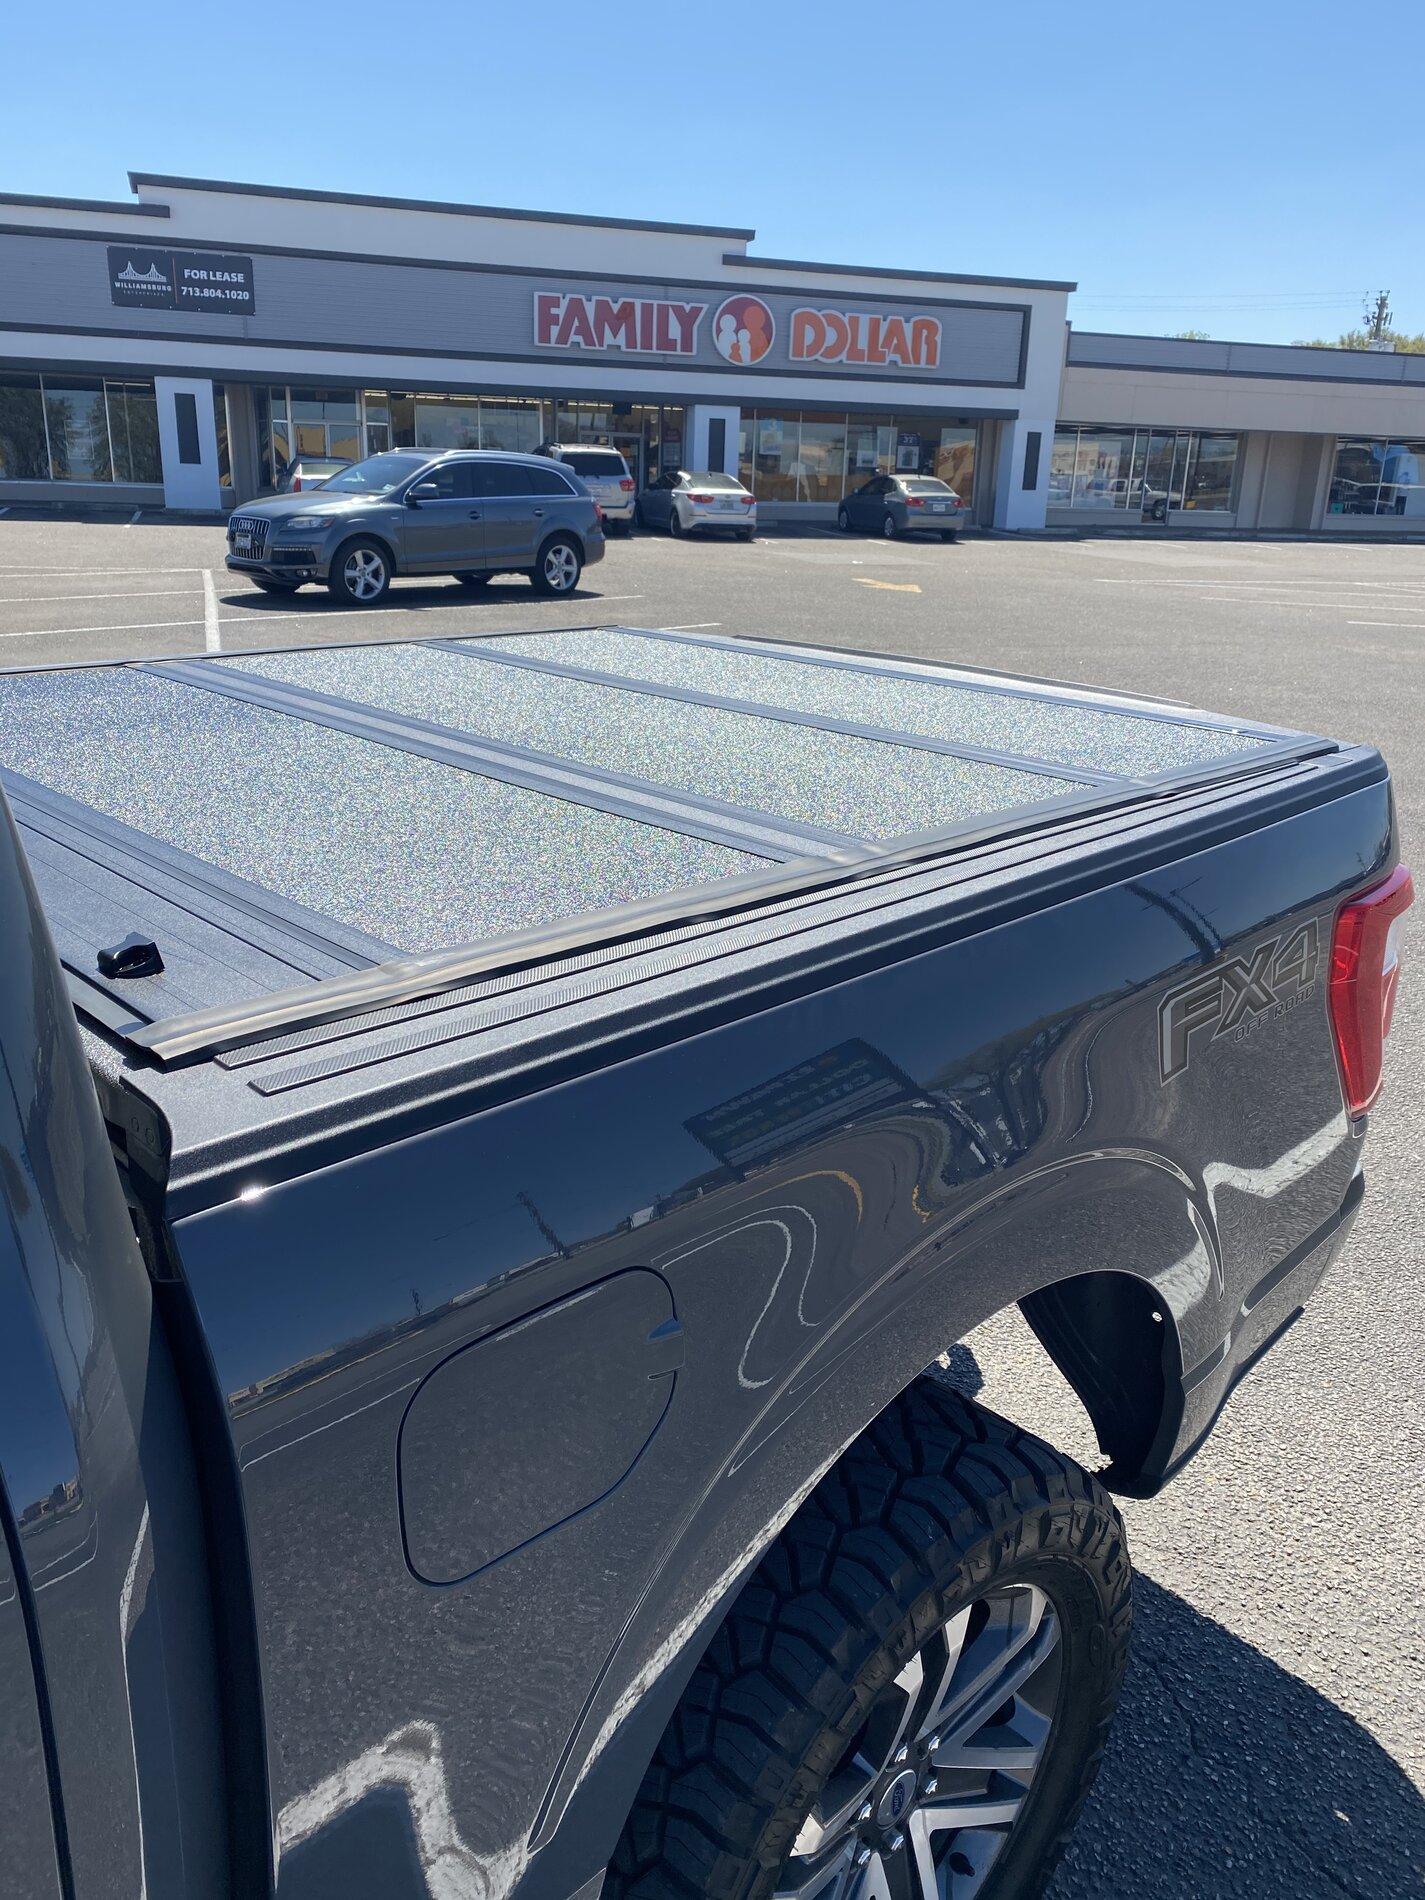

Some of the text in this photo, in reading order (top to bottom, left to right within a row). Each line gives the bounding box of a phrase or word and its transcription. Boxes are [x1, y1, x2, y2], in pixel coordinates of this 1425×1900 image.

[115, 282, 171, 291] WILLIAMSBURG
[184, 269, 244, 282] FOR LEASE
[181, 287, 249, 300] 713.804.1020
[535, 293, 942, 368] FAMILY DOLLAR
[1158, 917, 1320, 1086] FX4
[1235, 985, 1315, 1042] OFF ROAD
